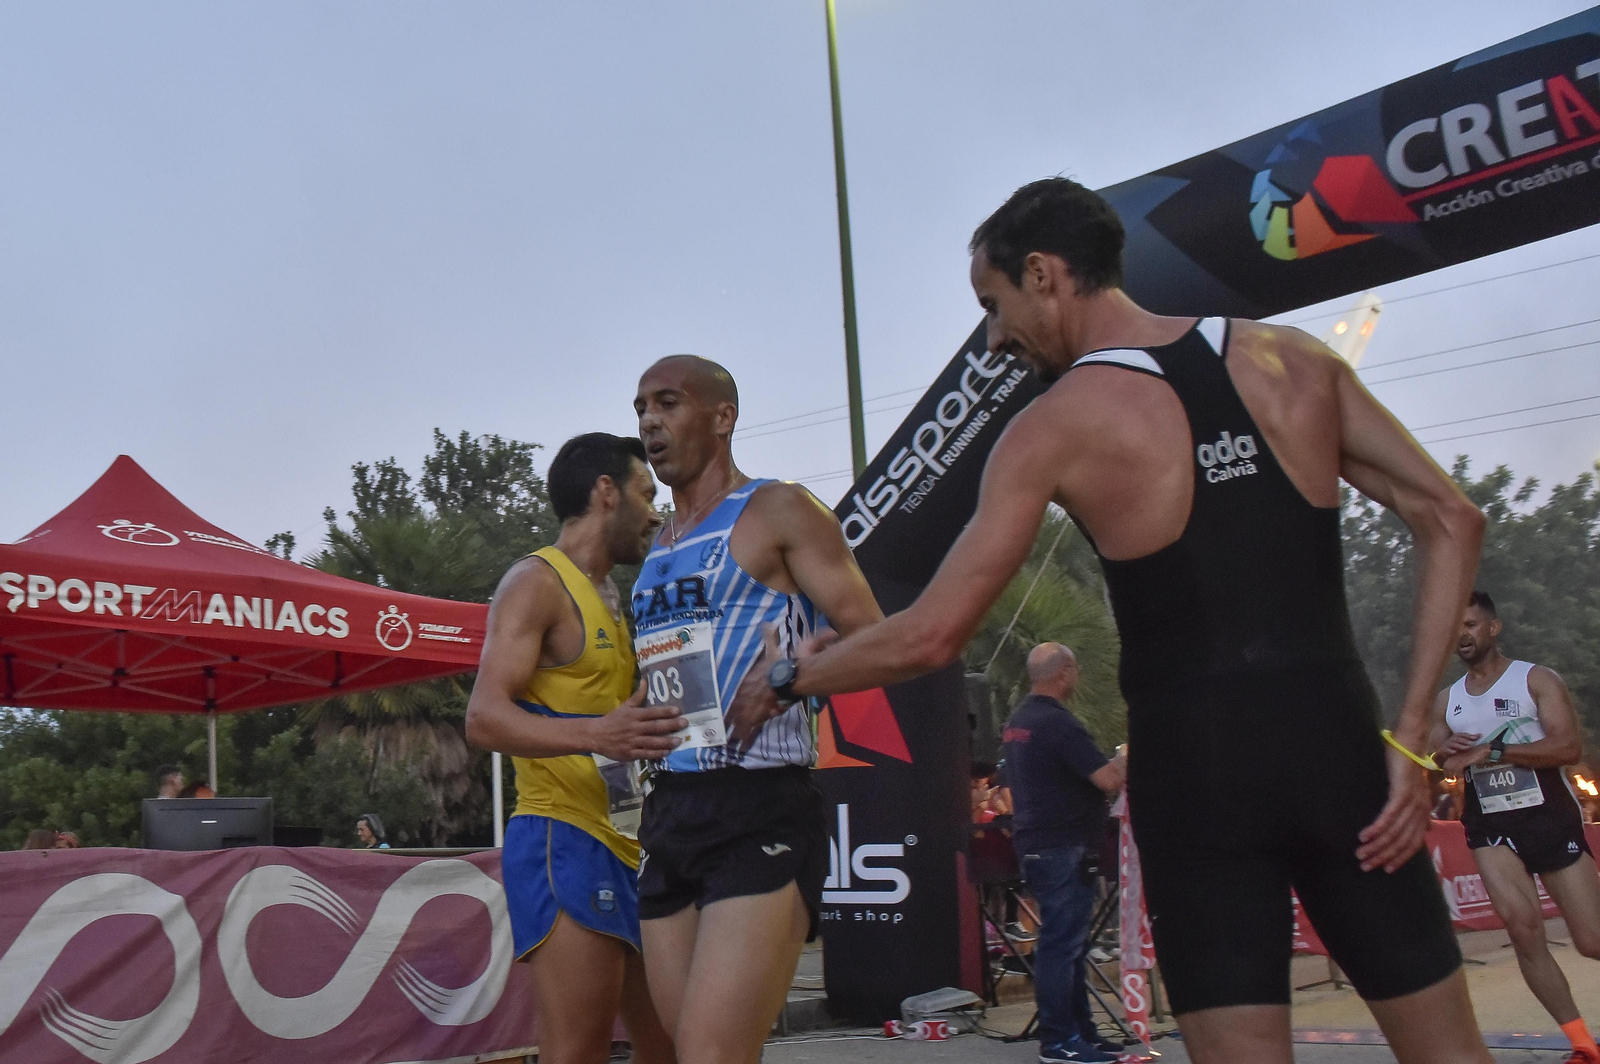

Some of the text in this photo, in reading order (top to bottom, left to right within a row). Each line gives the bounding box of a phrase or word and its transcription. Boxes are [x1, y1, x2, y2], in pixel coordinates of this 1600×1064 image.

[1424, 160, 1590, 222] Acción Creativa
[899, 473, 941, 514] TIENDA
[940, 409, 992, 467] RUNNING
[990, 367, 1029, 403] TRAIL
[1197, 430, 1259, 468] ada
[1488, 770, 1516, 789] 440
[853, 909, 904, 924] shop
